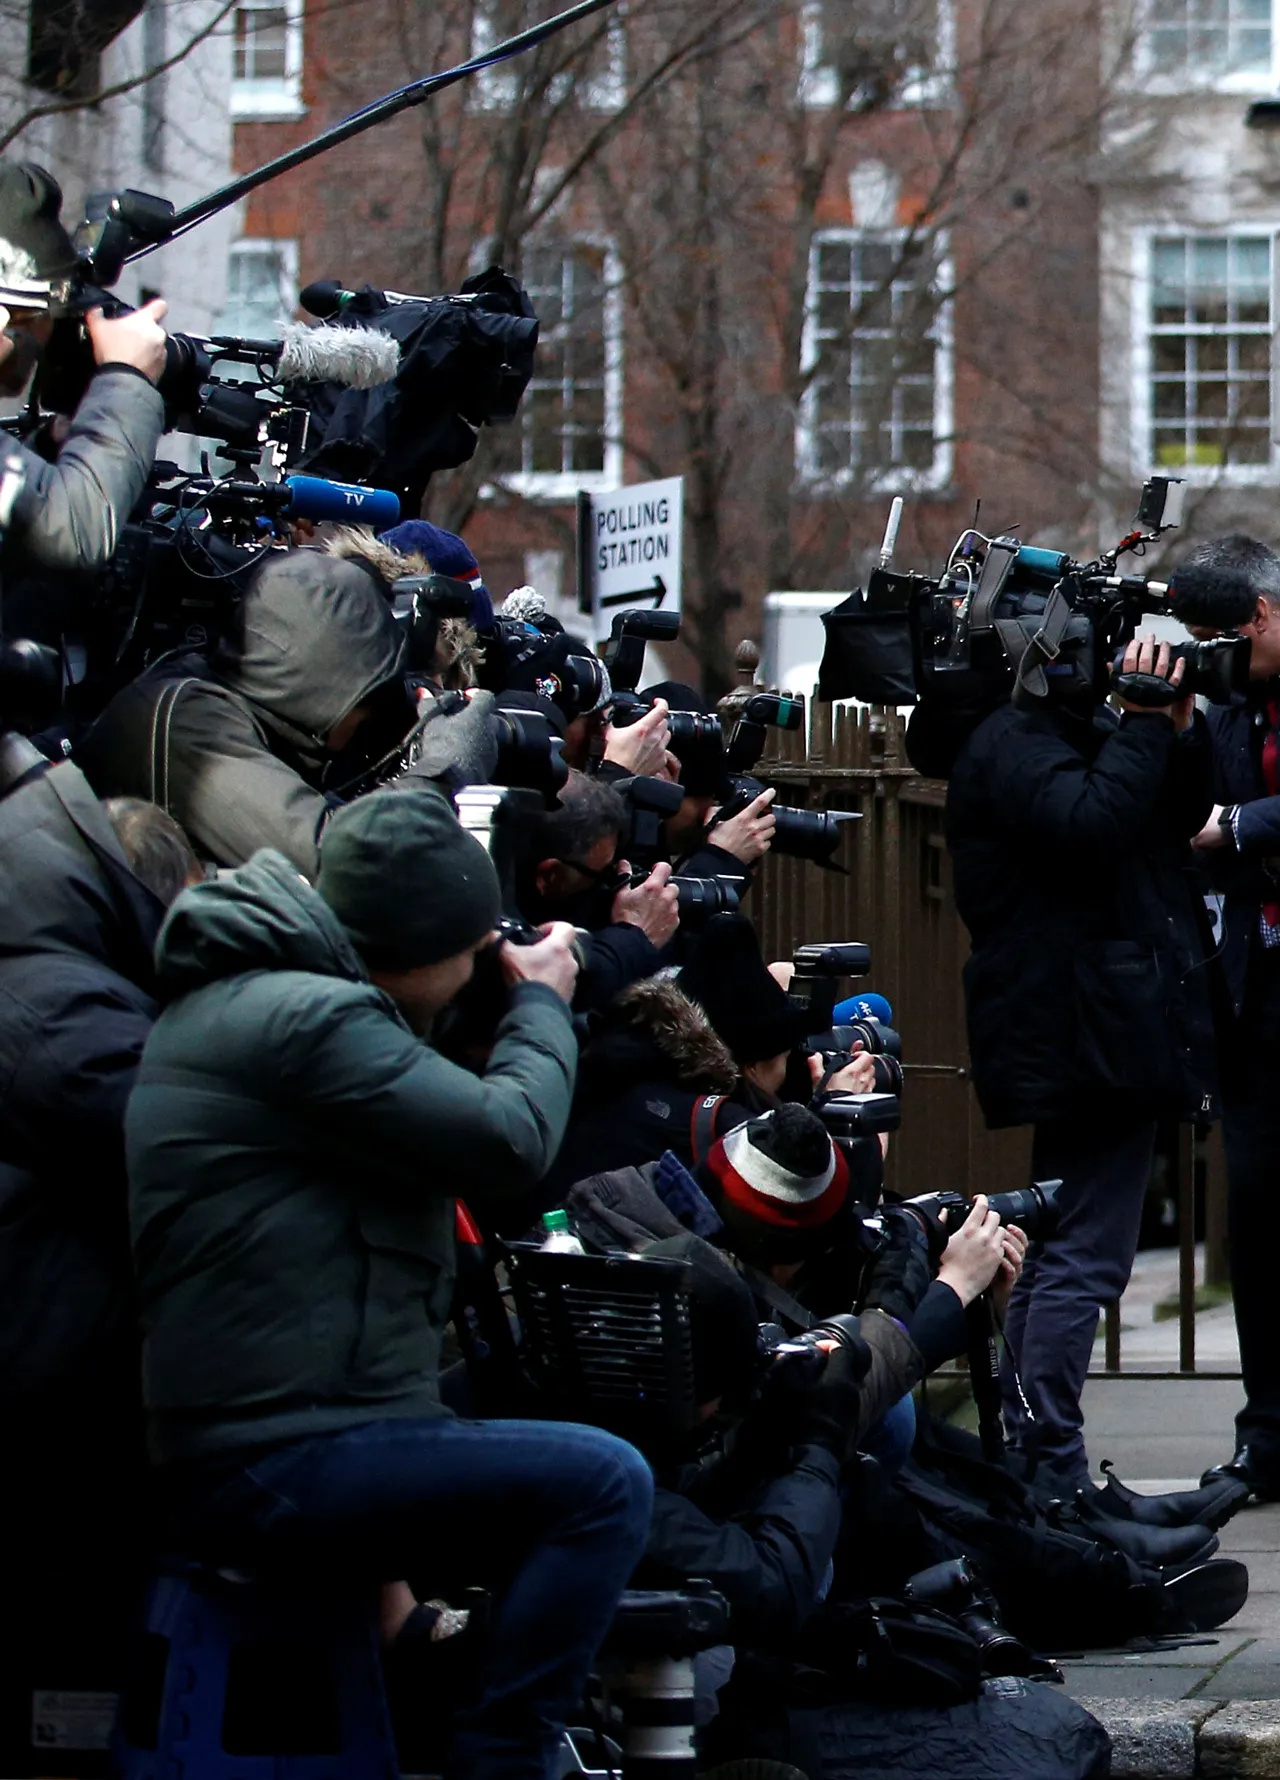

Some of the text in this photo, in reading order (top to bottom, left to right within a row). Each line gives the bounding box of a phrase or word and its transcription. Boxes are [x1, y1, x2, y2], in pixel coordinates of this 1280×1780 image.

[344, 492, 365, 506] TV
[596, 498, 669, 537] POLLING
[598, 534, 669, 570] STATION
[703, 1095, 719, 1108] EO
